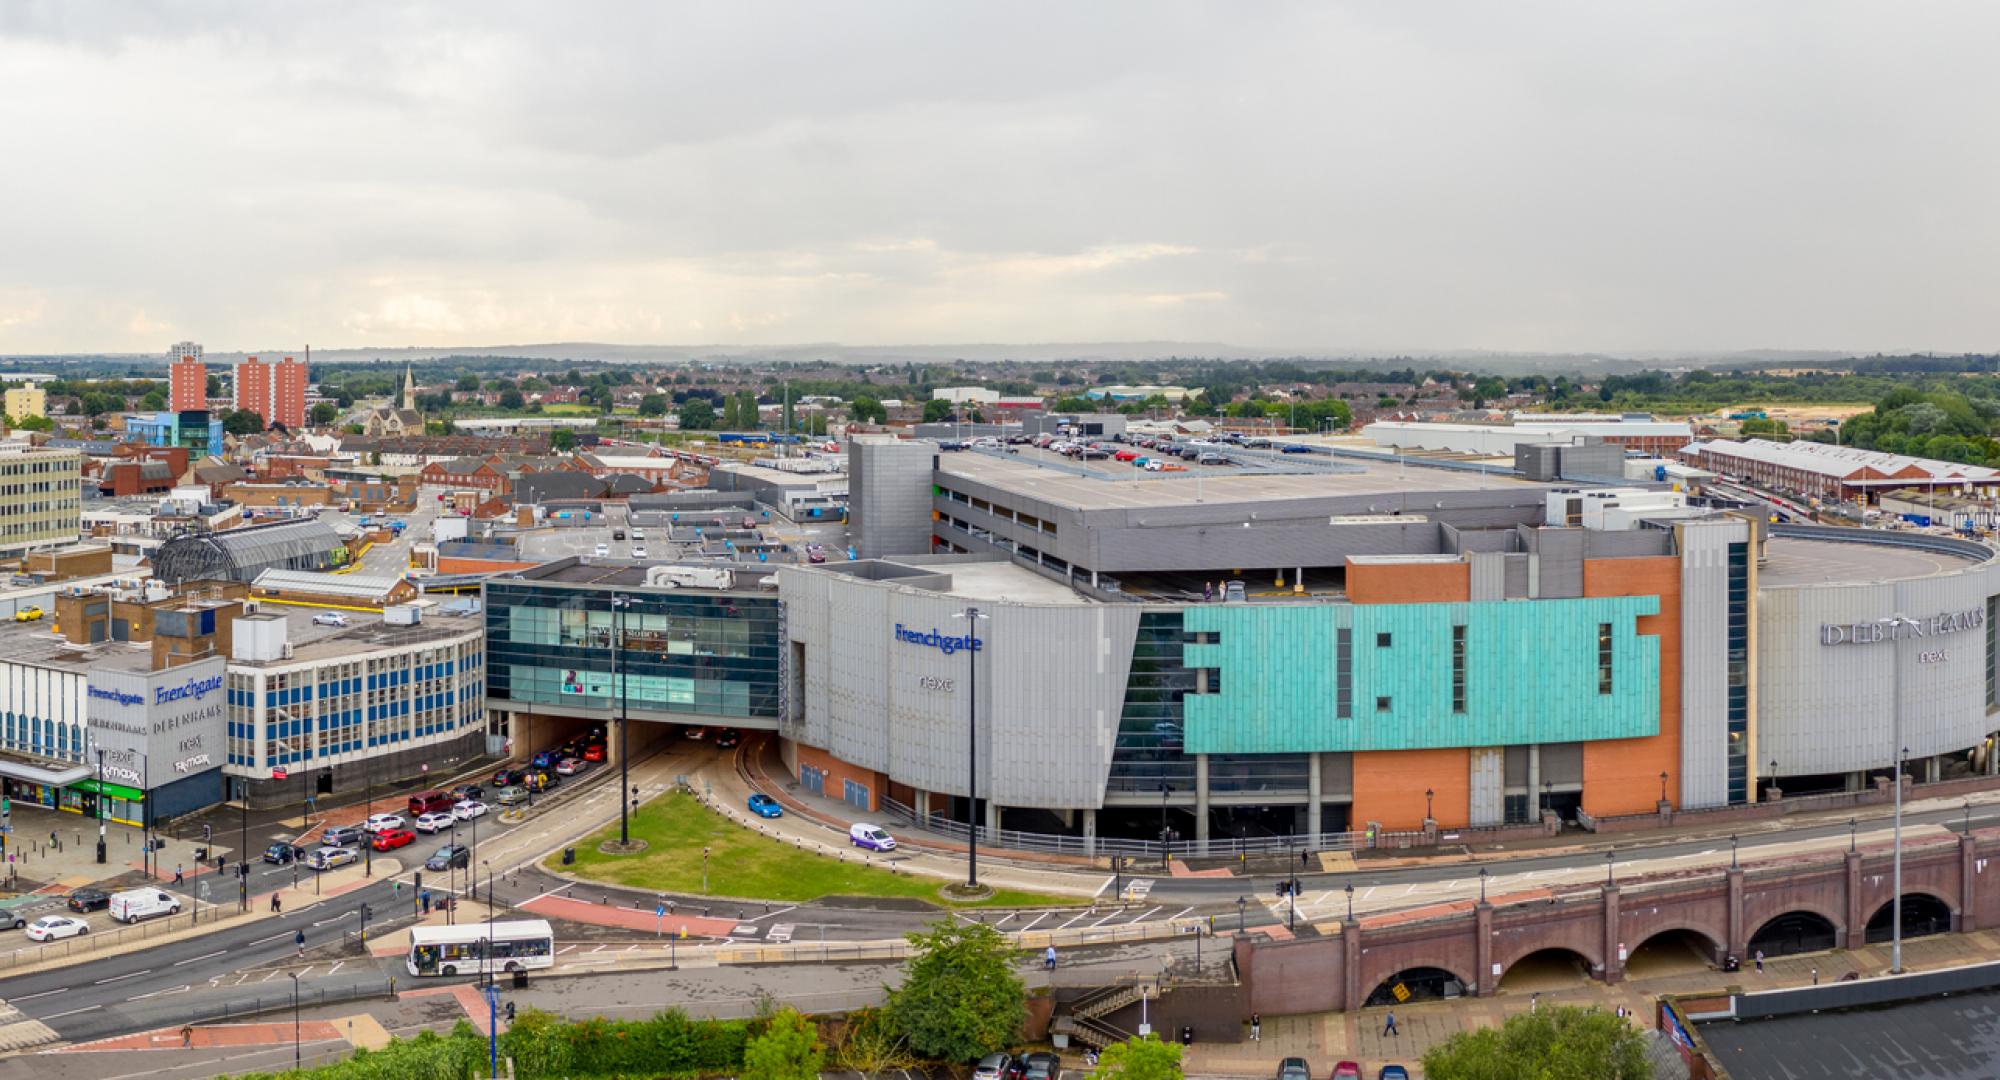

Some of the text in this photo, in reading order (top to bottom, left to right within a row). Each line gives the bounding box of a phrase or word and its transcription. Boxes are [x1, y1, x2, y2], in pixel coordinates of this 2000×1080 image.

[895, 623, 983, 655] Frenchgate
[88, 685, 144, 706] Frenchgate
[155, 675, 223, 705] Frenchgate
[920, 676, 953, 693] next
[153, 704, 222, 734] DEBENHAMS
